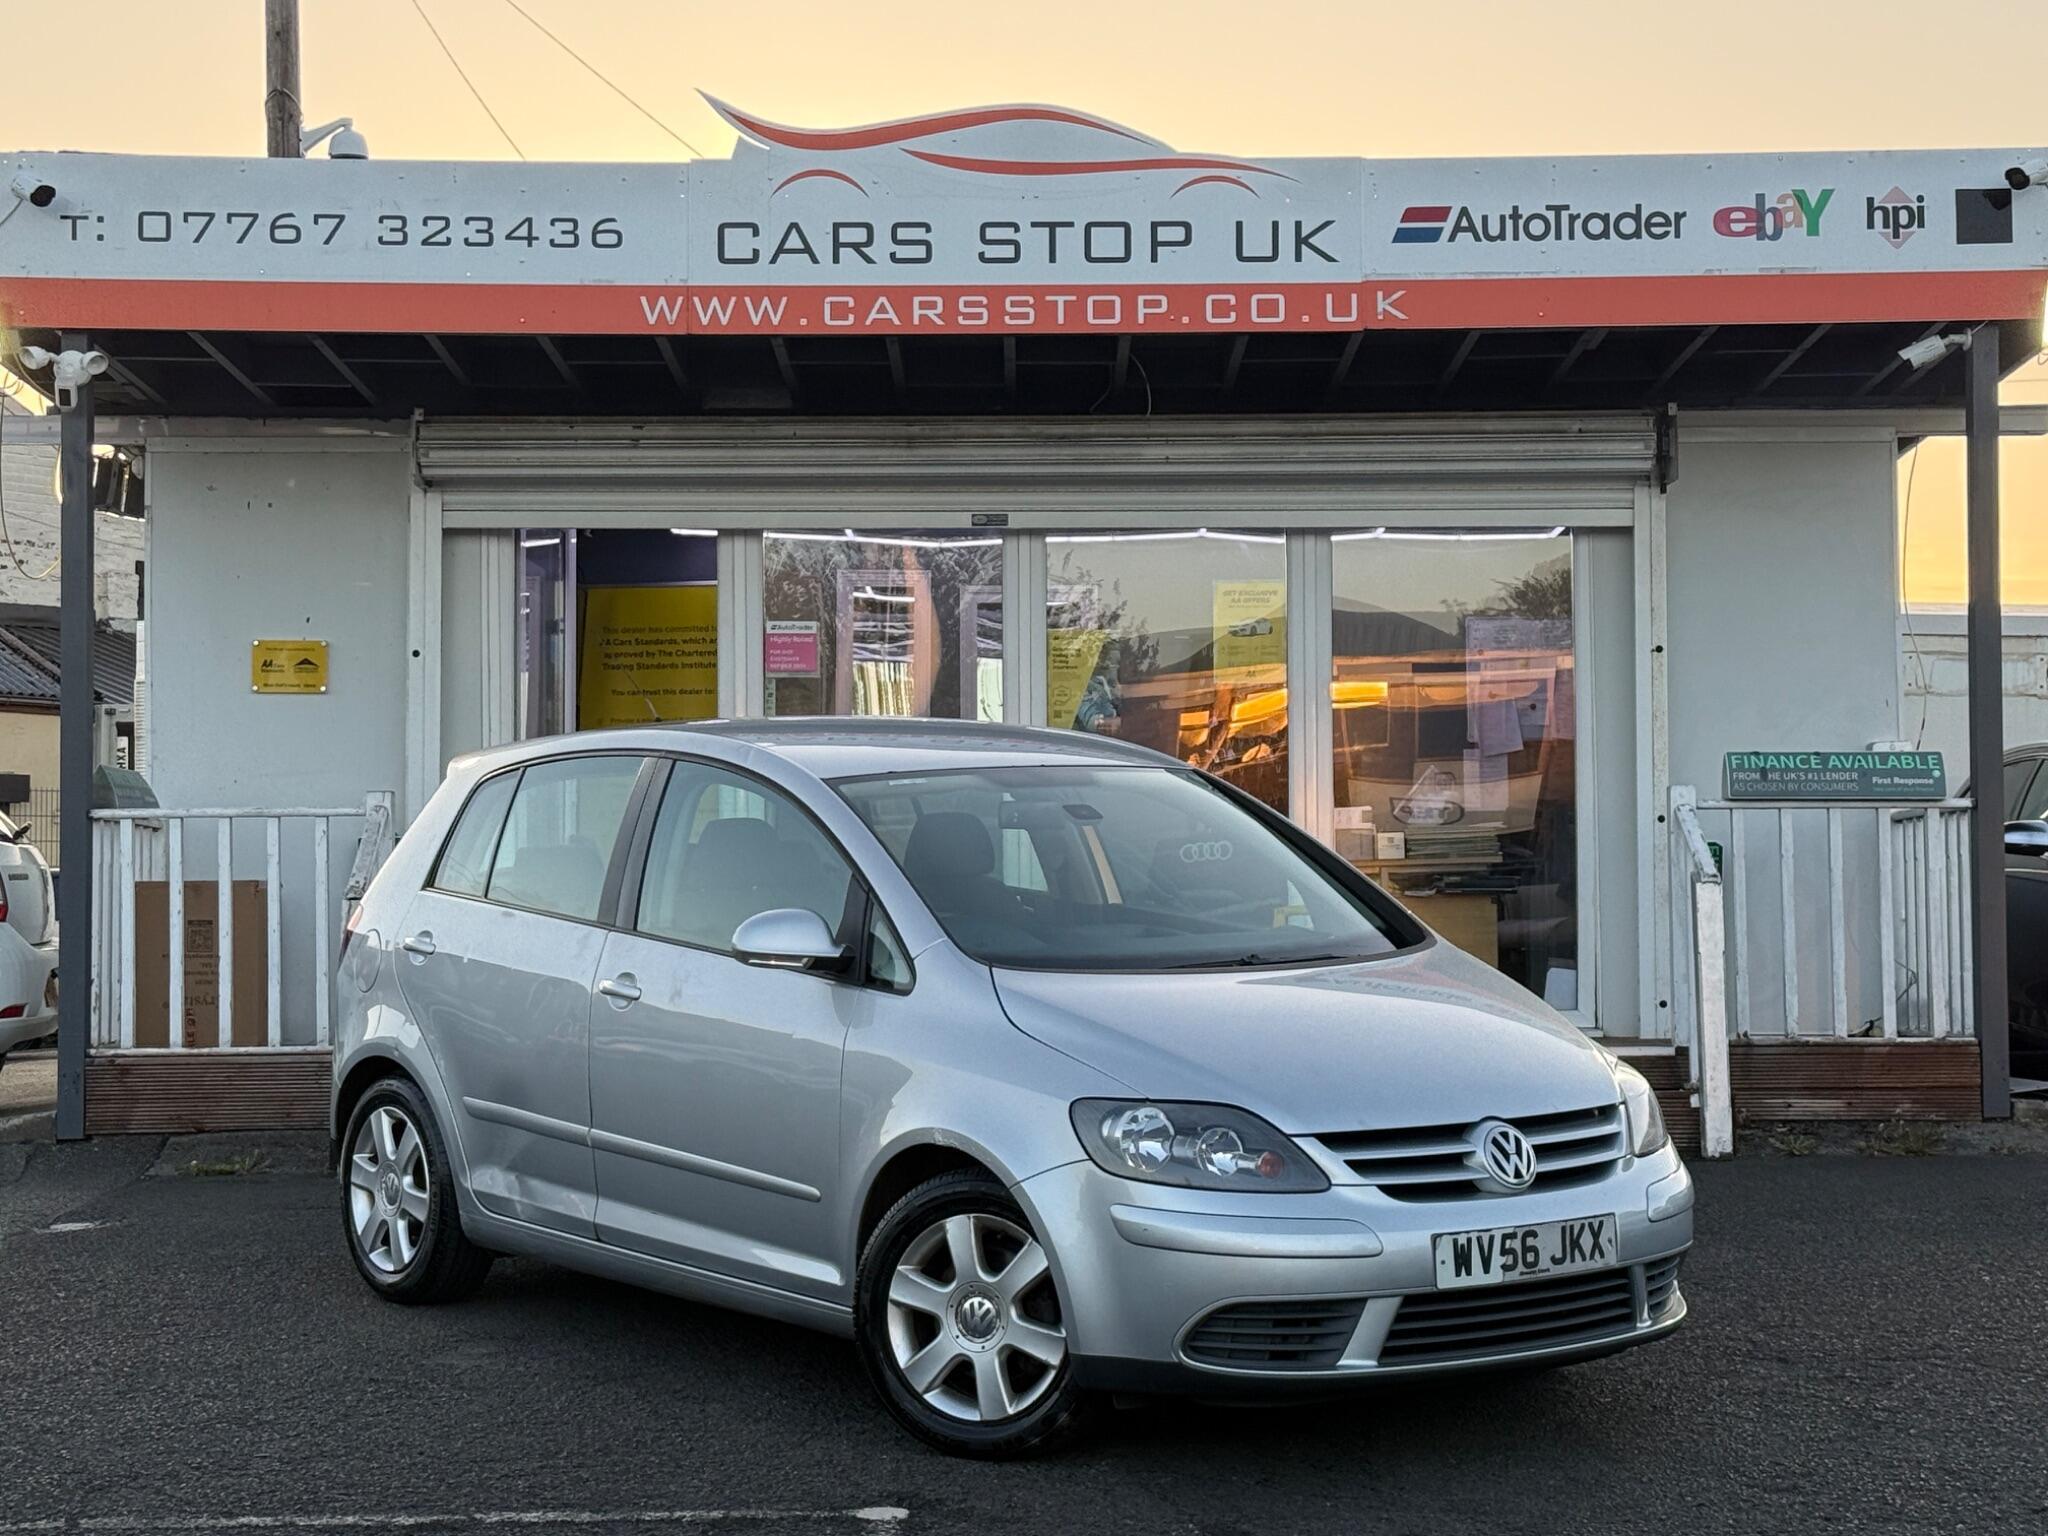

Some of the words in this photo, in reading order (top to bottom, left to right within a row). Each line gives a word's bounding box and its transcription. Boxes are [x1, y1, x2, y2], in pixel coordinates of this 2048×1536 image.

[1448, 204, 1687, 243] AutoTrader
[1866, 194, 1926, 240] hpi
[60, 214, 104, 242] T:
[137, 212, 346, 246] 07767
[377, 214, 624, 249] 323436
[717, 221, 933, 265] CARS
[977, 220, 1193, 265] STOP
[1235, 219, 1341, 263] UK
[639, 288, 1408, 326] WWW.CARSSTOP.CO.UK
[664, 625, 710, 633] committed
[682, 636, 707, 645] which
[659, 649, 673, 657] The
[636, 661, 680, 671] Standards
[1730, 754, 1823, 769] FINANCE
[1828, 754, 1940, 769] AVAILABLE
[1733, 771, 1761, 781] FROM
[1783, 771, 1806, 781] UK'S
[1820, 771, 1859, 781] LENDER
[1871, 776, 1892, 785] First
[1893, 776, 1935, 787] Response
[1733, 782, 1746, 792] AS
[1746, 782, 1786, 792] CHOSEN
[1787, 782, 1800, 792] BY
[1800, 782, 1860, 792] CONSUMERS
[1452, 1229, 1540, 1278] WV56
[1550, 1219, 1606, 1267] JKX
